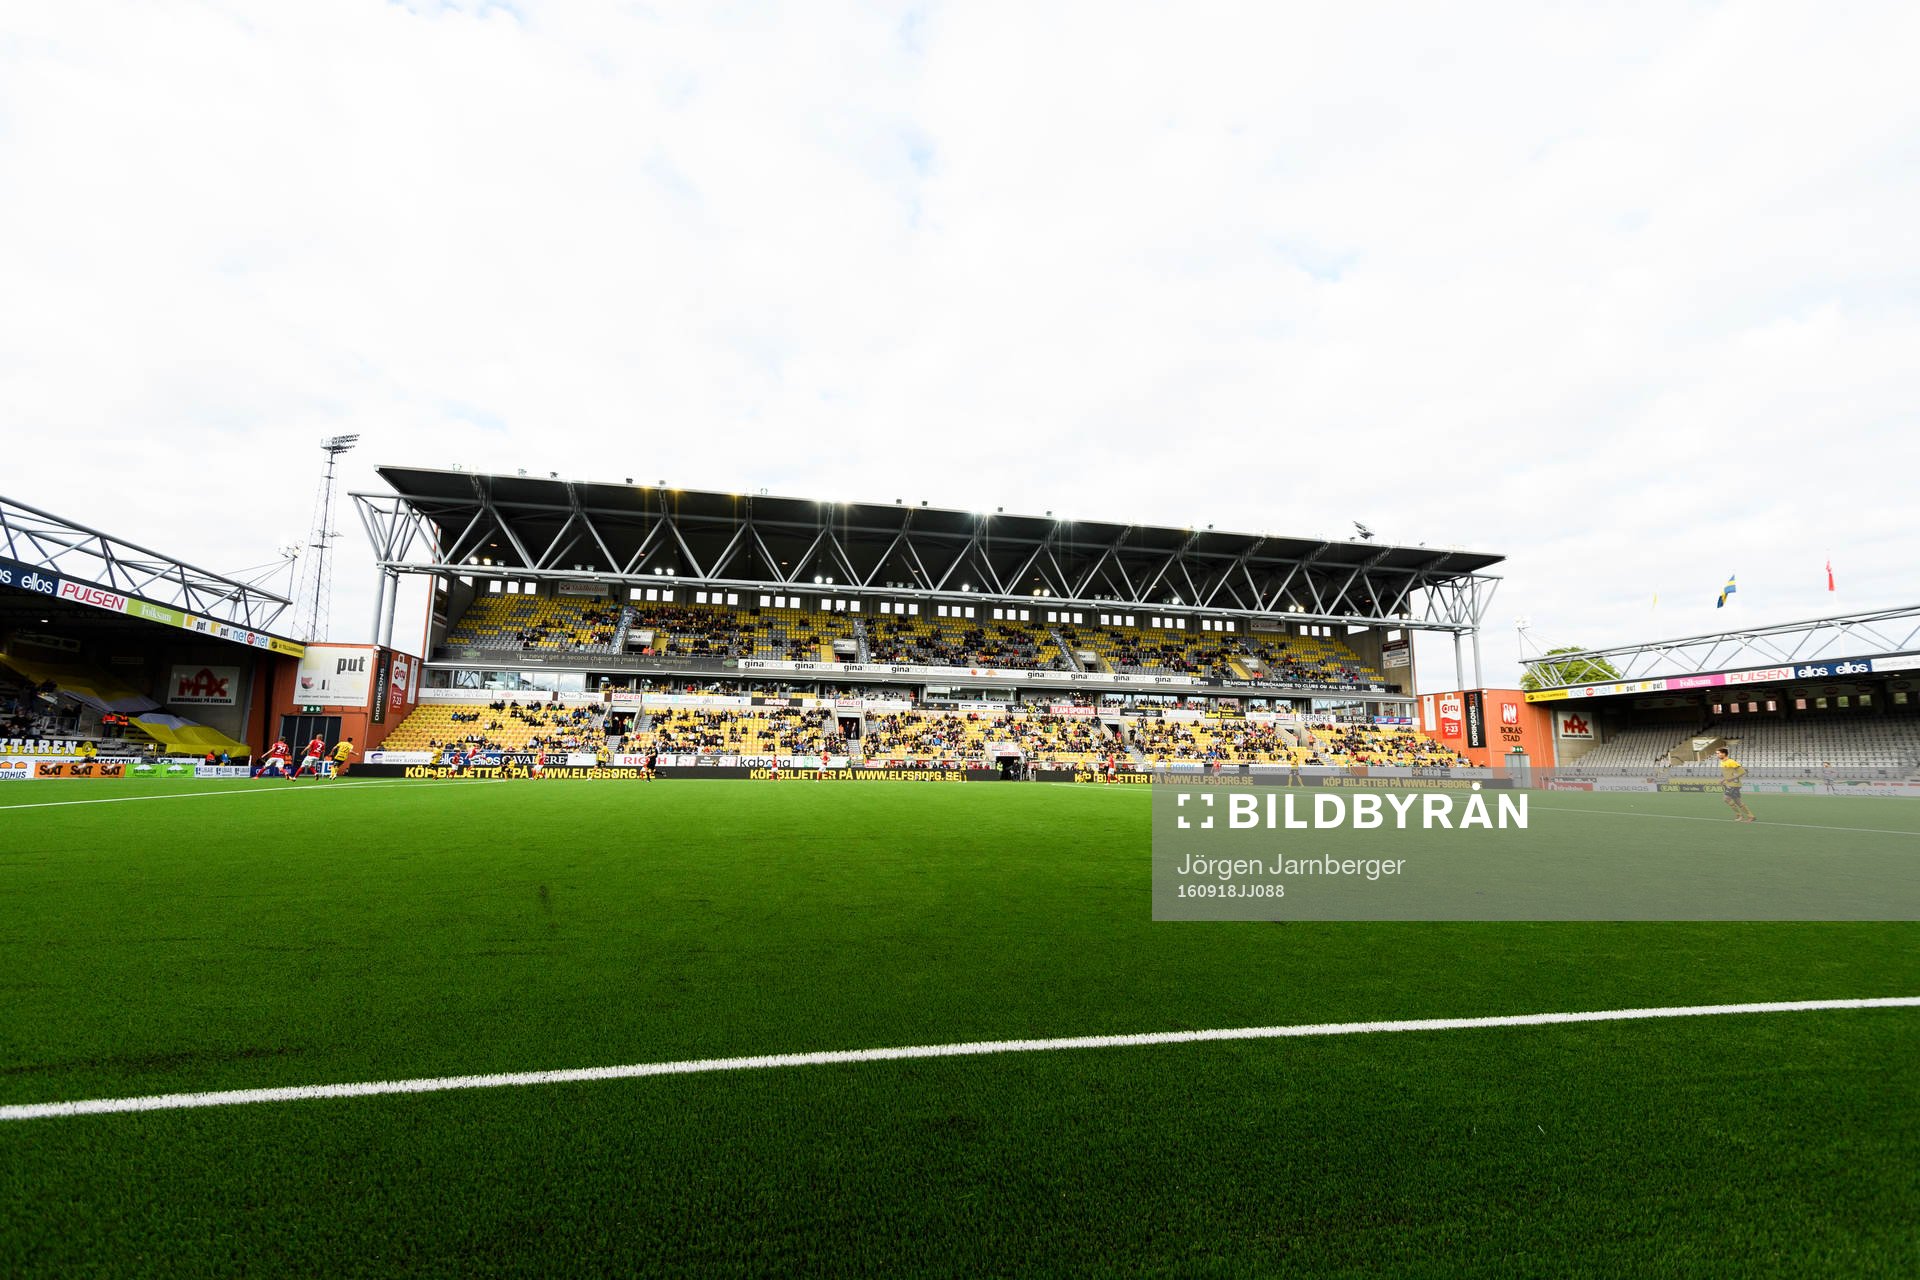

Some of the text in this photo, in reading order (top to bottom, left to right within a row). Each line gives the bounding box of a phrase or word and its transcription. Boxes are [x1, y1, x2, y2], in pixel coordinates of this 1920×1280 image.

[21, 572, 53, 594] ellos
[62, 583, 125, 610] PULSEN
[337, 656, 366, 675] put
[1798, 666, 1828, 678] ellos
[1836, 661, 1868, 675] ellos
[178, 667, 229, 698] MAX
[1679, 677, 1712, 689] Folksam
[1730, 668, 1789, 684] PULSEN
[1051, 706, 1096, 715] TEAM SPORTIA
[1563, 713, 1589, 734] MAX
[1503, 734, 1521, 742] STAD
[839, 767, 853, 780] PÅ
[1323, 776, 1341, 787] KÖP
[1343, 777, 1388, 788] BILJETTER
[1389, 776, 1402, 788] PÅ
